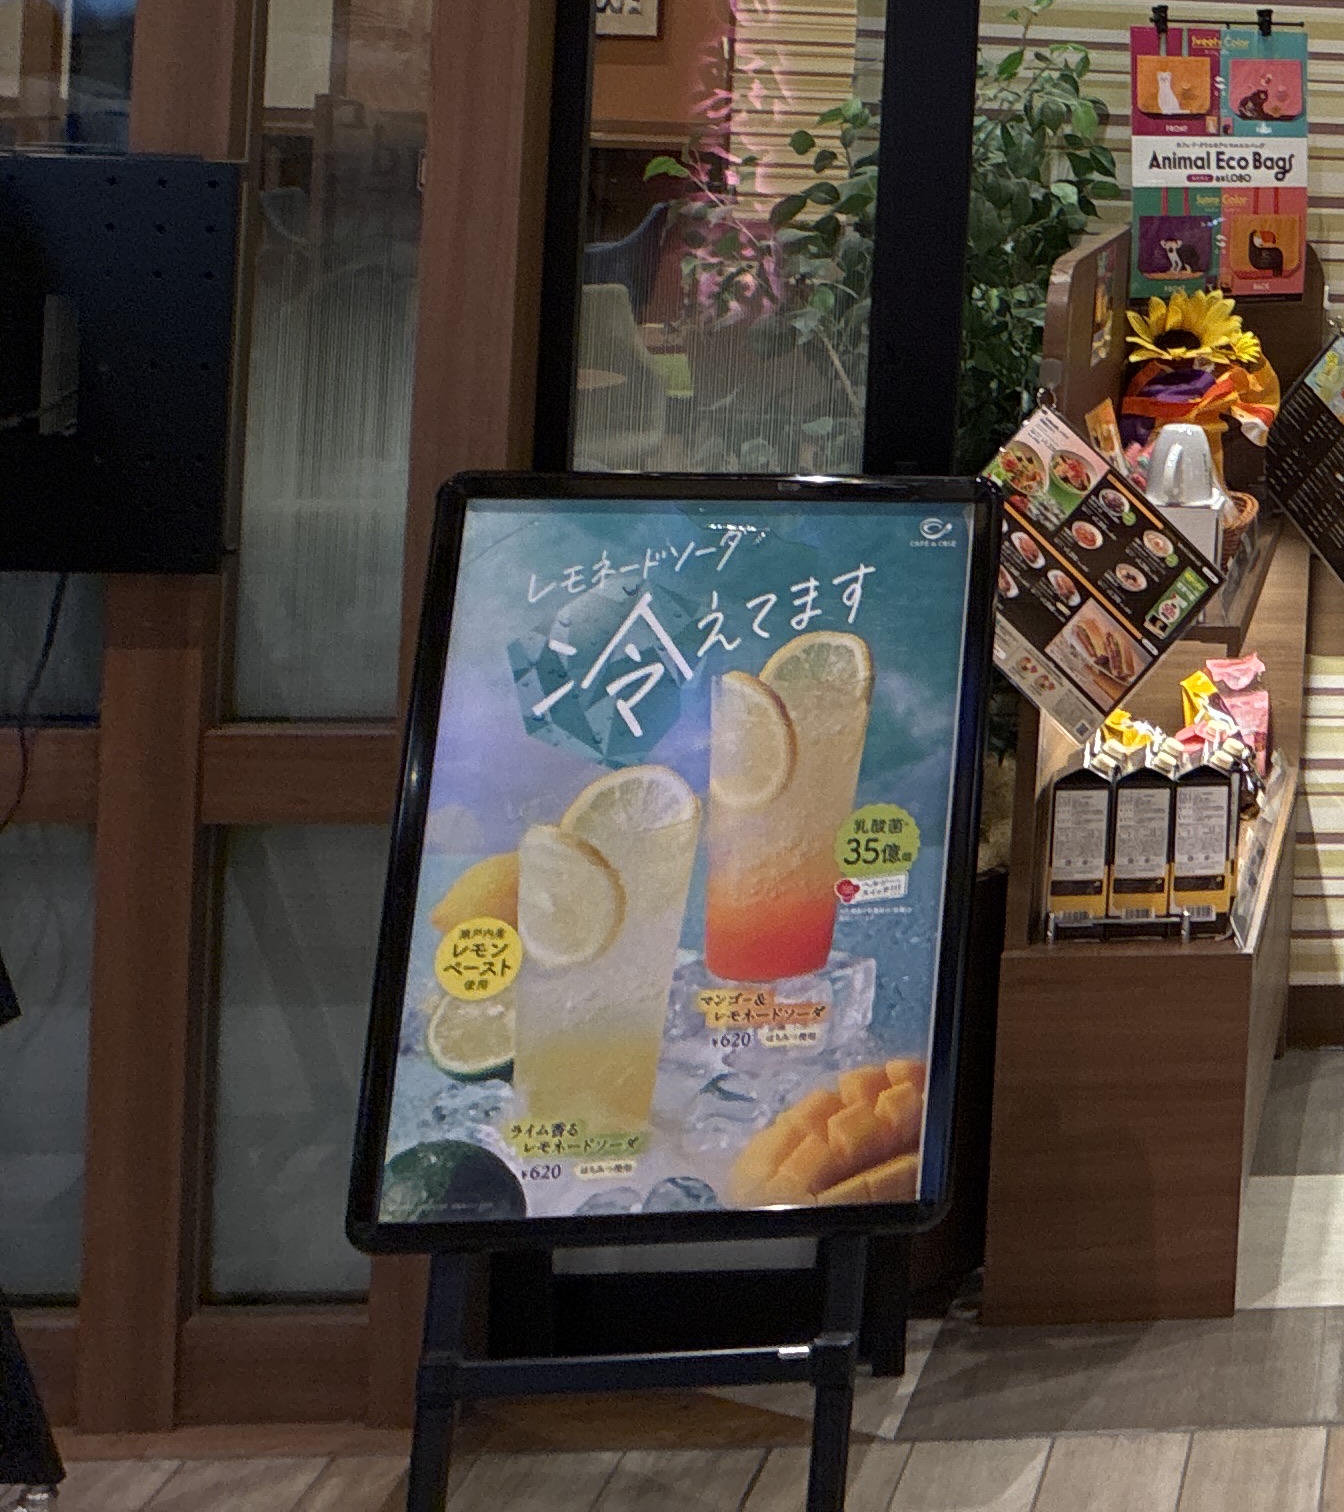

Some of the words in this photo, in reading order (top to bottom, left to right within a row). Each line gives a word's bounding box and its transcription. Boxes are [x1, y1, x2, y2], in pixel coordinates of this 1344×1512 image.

[1149, 151, 1211, 171] Animal
[1216, 151, 1250, 171] Eco
[1252, 151, 1296, 182] Bags
[528, 528, 767, 603] レモネードソーダ
[532, 563, 876, 737] 冷えてます
[453, 943, 509, 958] レモン
[443, 957, 511, 977] ペースト
